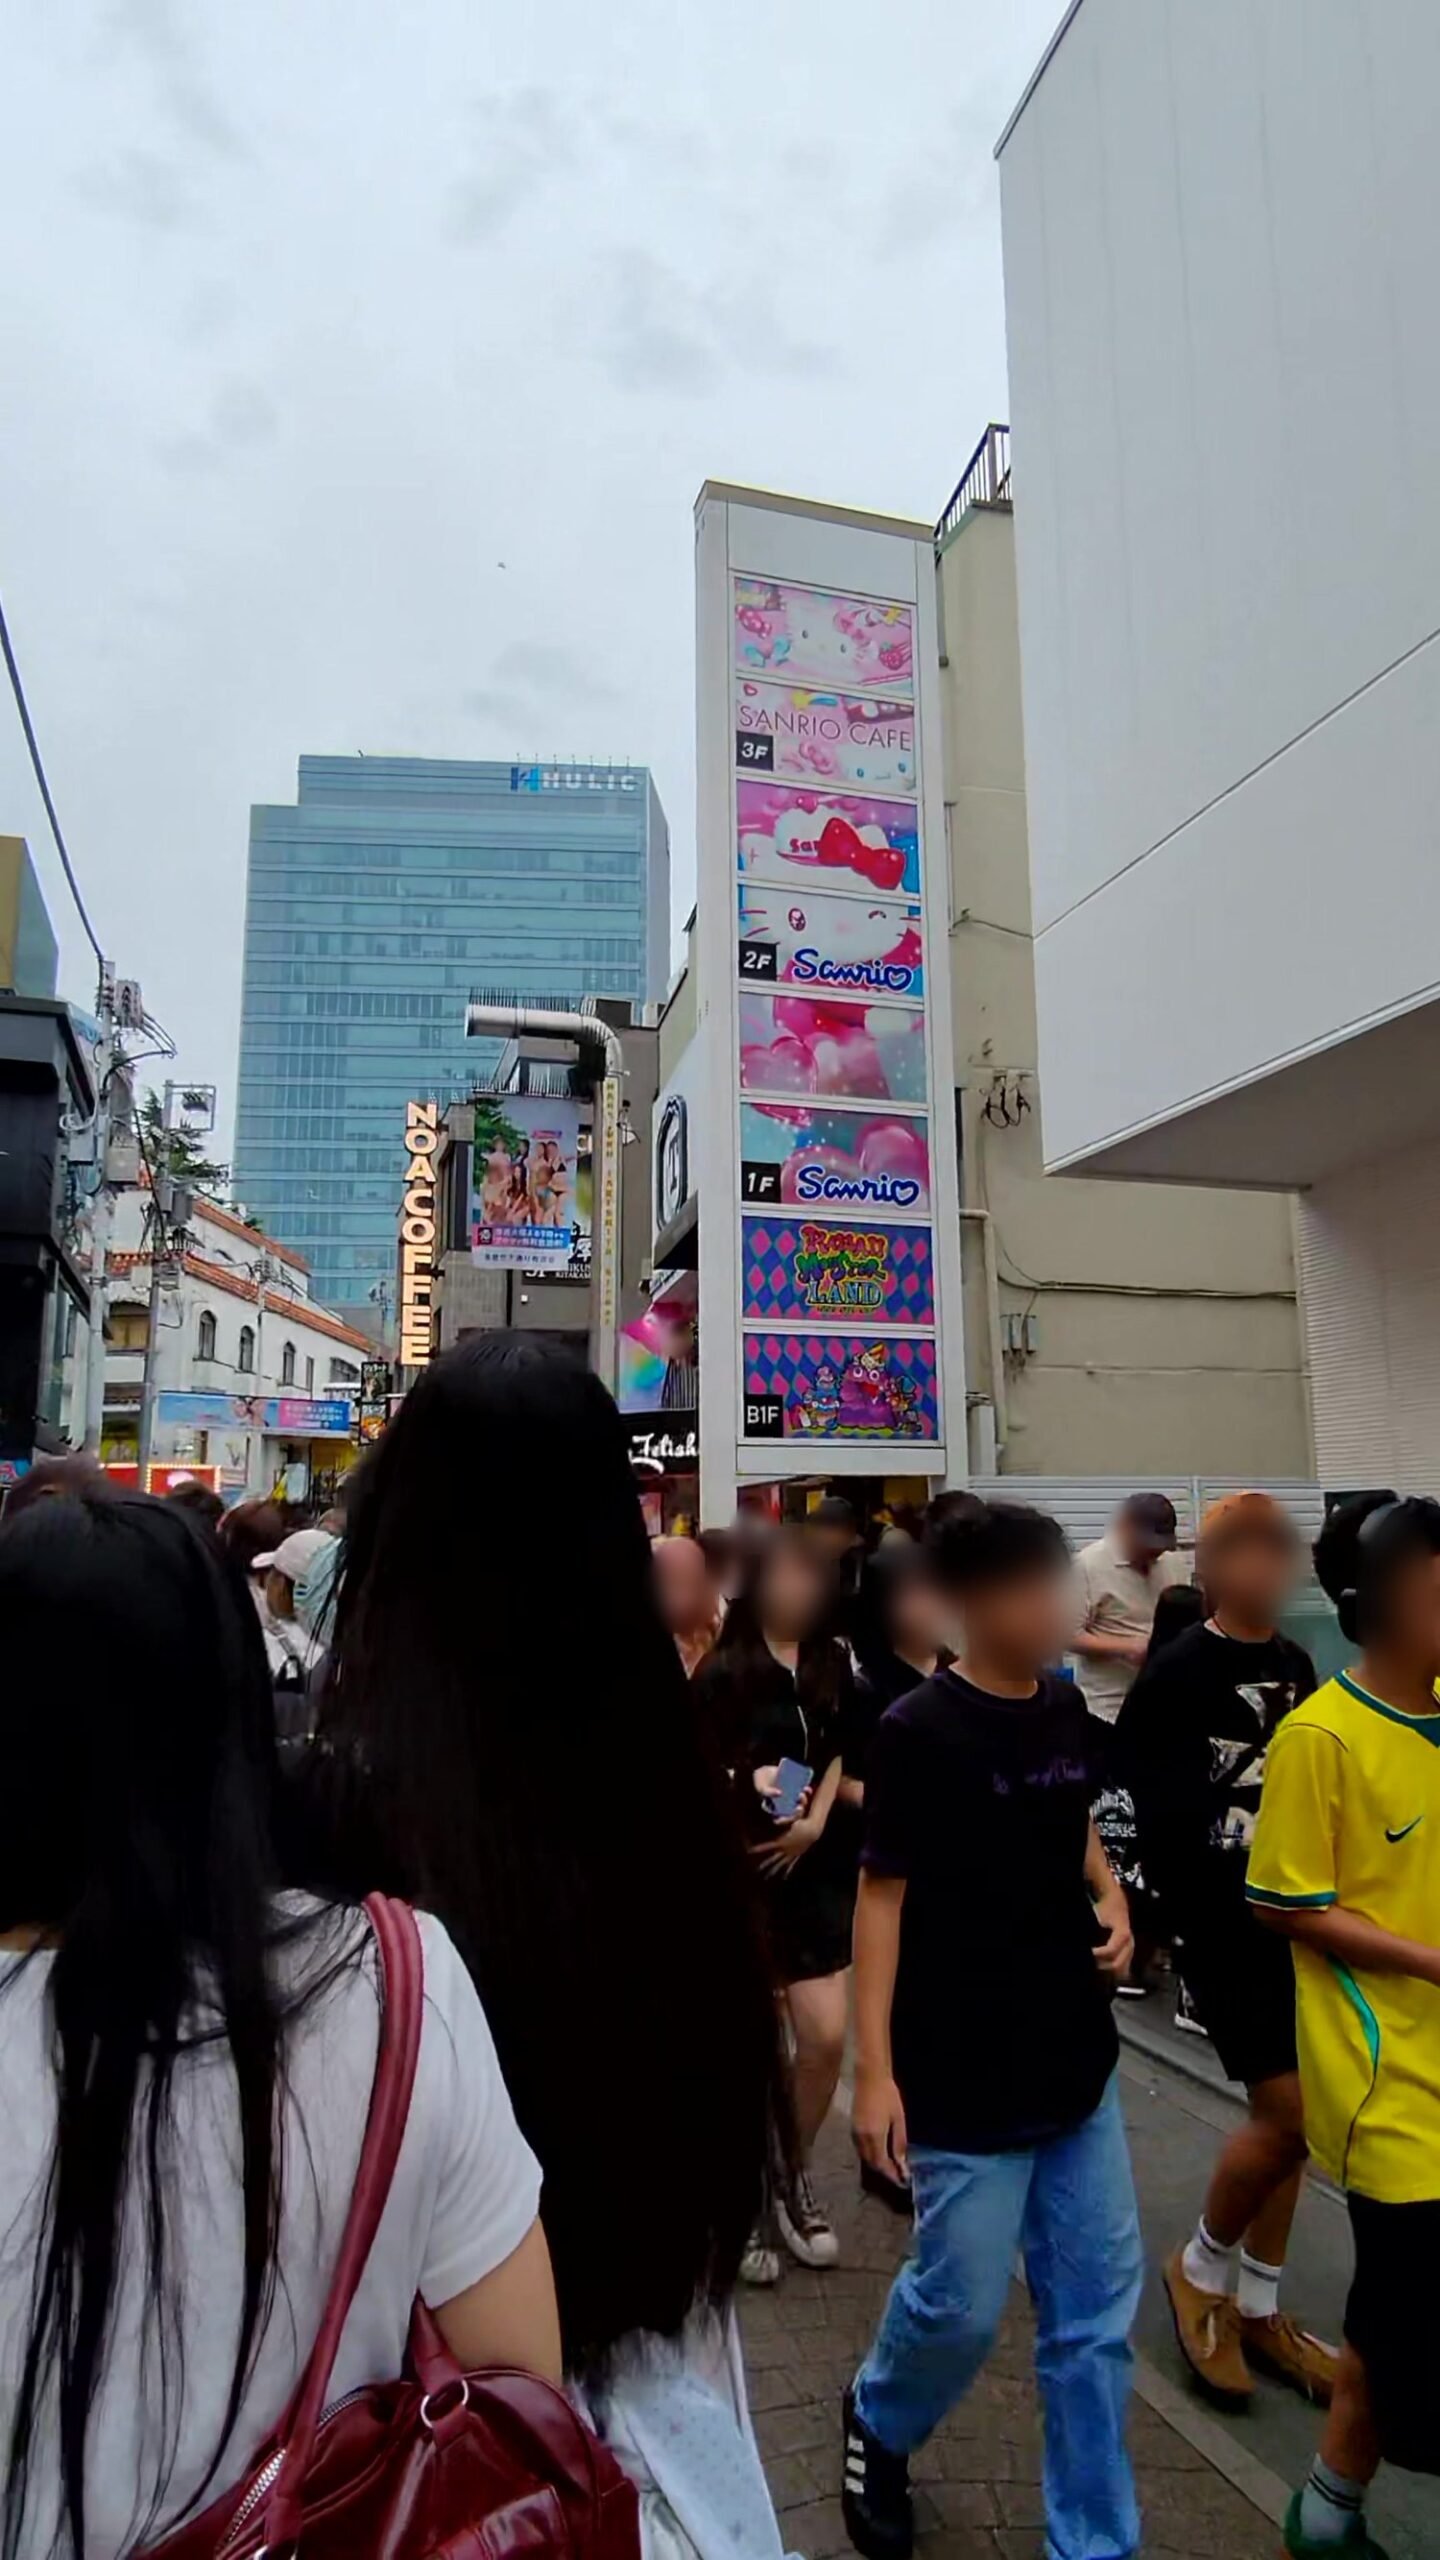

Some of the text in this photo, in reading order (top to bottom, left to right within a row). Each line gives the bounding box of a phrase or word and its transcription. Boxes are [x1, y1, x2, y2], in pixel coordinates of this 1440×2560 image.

[740, 705, 911, 752] SANRIO CAFE
[741, 742, 769, 761] 3F
[543, 771, 635, 791] HULIC
[743, 951, 772, 970] 2F
[793, 948, 913, 991] Sanrio
[748, 1172, 775, 1193] 1F
[798, 1166, 919, 1206] Sanrio
[401, 1188, 436, 1365] COFFEE
[806, 1279, 882, 1306] LAND
[747, 1405, 779, 1424] B1F
